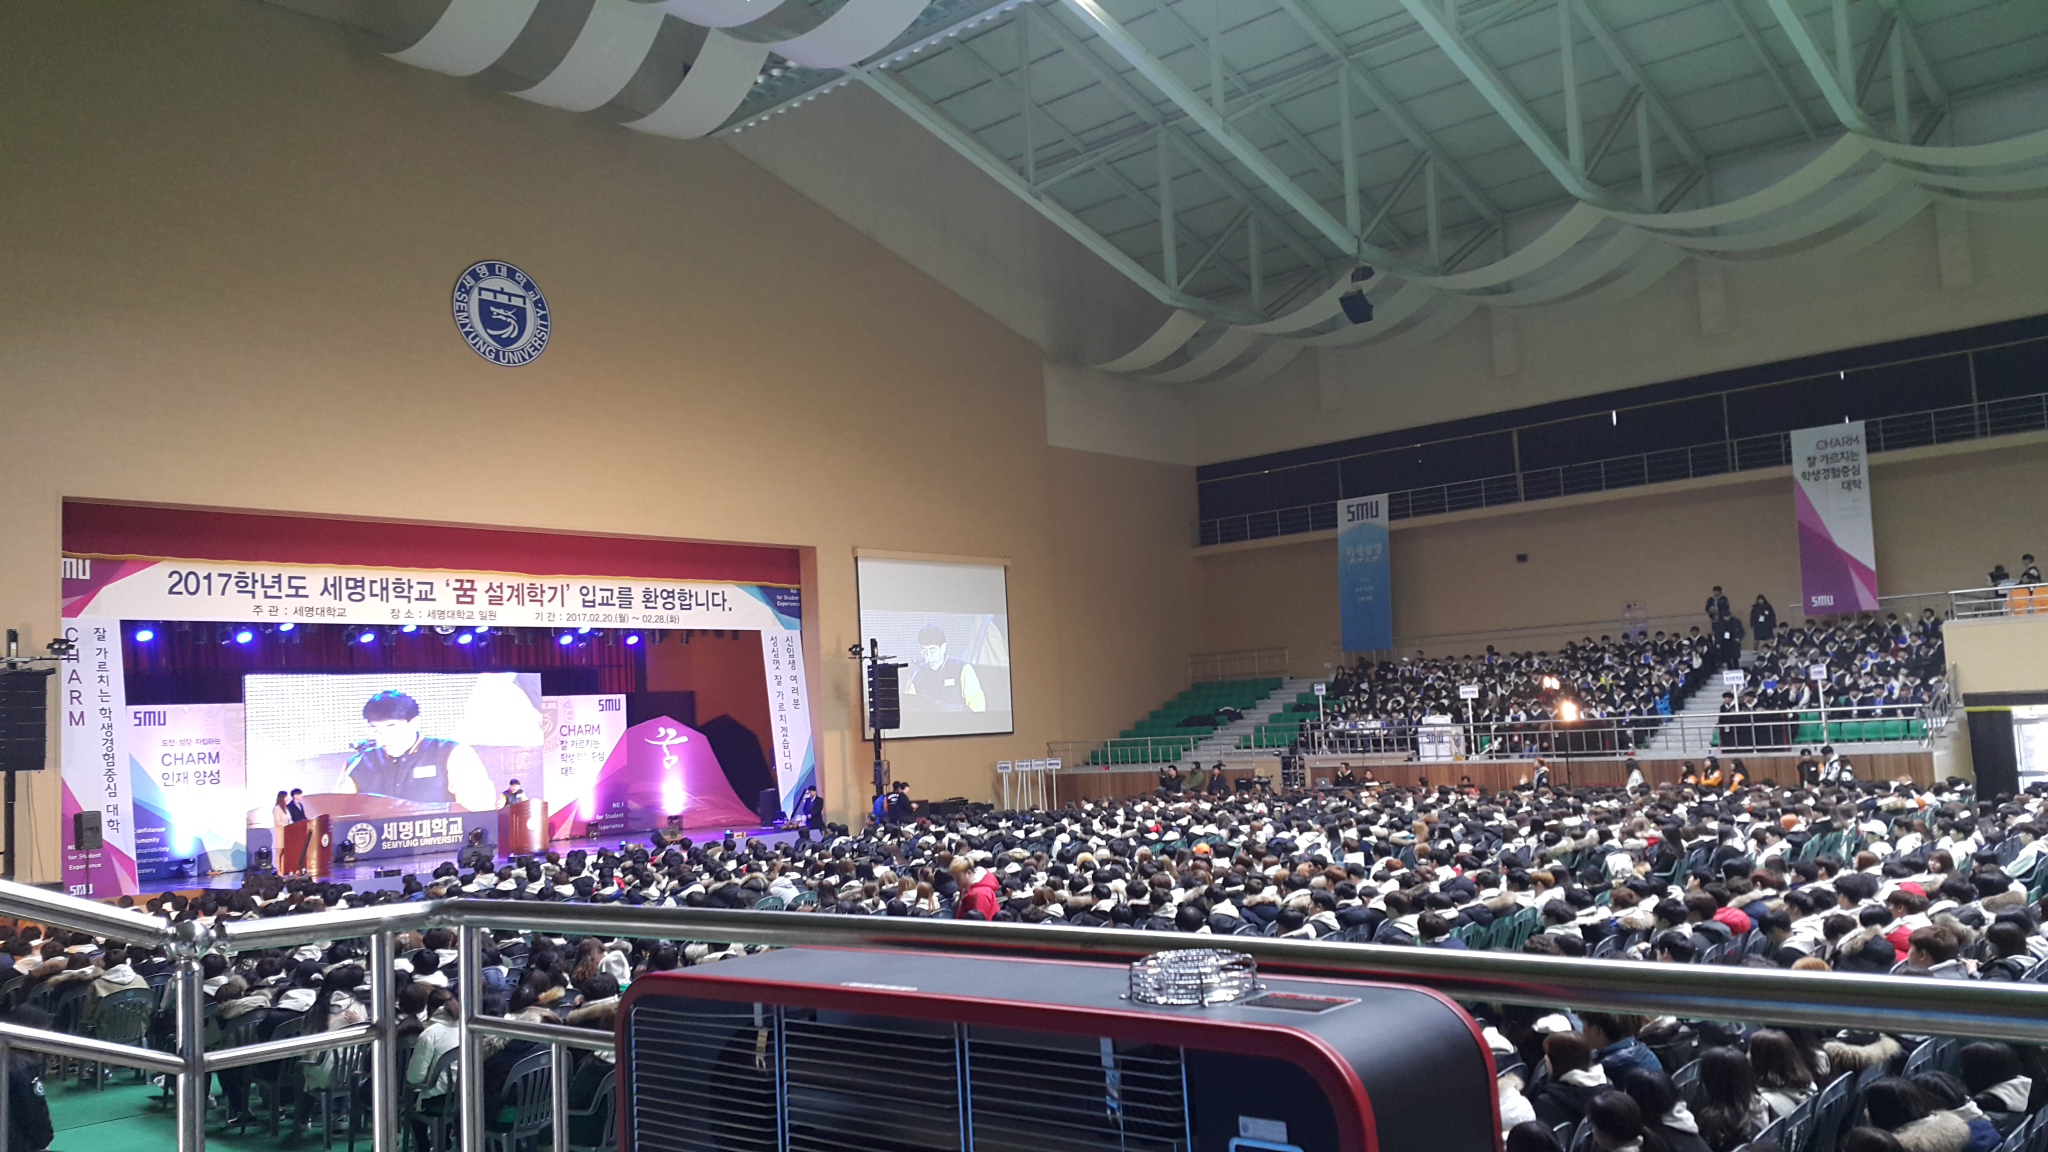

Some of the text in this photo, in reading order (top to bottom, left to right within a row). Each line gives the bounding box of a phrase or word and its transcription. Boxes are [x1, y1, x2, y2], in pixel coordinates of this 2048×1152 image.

[462, 264, 541, 301] 세명대학교
[456, 292, 549, 364] SEMYUNG UNIVERSITY
[1816, 435, 1859, 450] CHARM
[1806, 450, 1860, 468] 잘 가르치는
[1801, 464, 1861, 482] 학생경험중심
[1841, 478, 1862, 491] 대학
[1346, 501, 1379, 522] SMU
[62, 558, 91, 579] MU
[167, 570, 310, 600] 2017학년도
[319, 574, 437, 603] 세명대학교
[578, 585, 635, 610] 입교를
[641, 586, 734, 613] 환영합니다.
[1811, 595, 1834, 607] SMU
[293, 605, 347, 618] 세명대학교
[427, 608, 475, 621] 세명대학교
[478, 610, 497, 621] 일원
[642, 615, 680, 625] 02.28.(화)
[64, 627, 85, 727] CHARM
[785, 635, 801, 710] 신입생 여러분
[598, 698, 622, 712] SMU
[133, 711, 167, 727] SMU
[93, 627, 121, 834] 잘 가르치는 학생경험중심 대학
[559, 723, 601, 737] CHARM
[776, 690, 793, 773] 가르치겠습니다
[161, 751, 220, 767] CHARM
[161, 769, 221, 787] 인재 양성
[381, 817, 464, 841] 세명대학교
[136, 846, 170, 854] daptability
[381, 835, 464, 850] SEMYUNG UNIVERSITY
[68, 862, 102, 871] Experence
